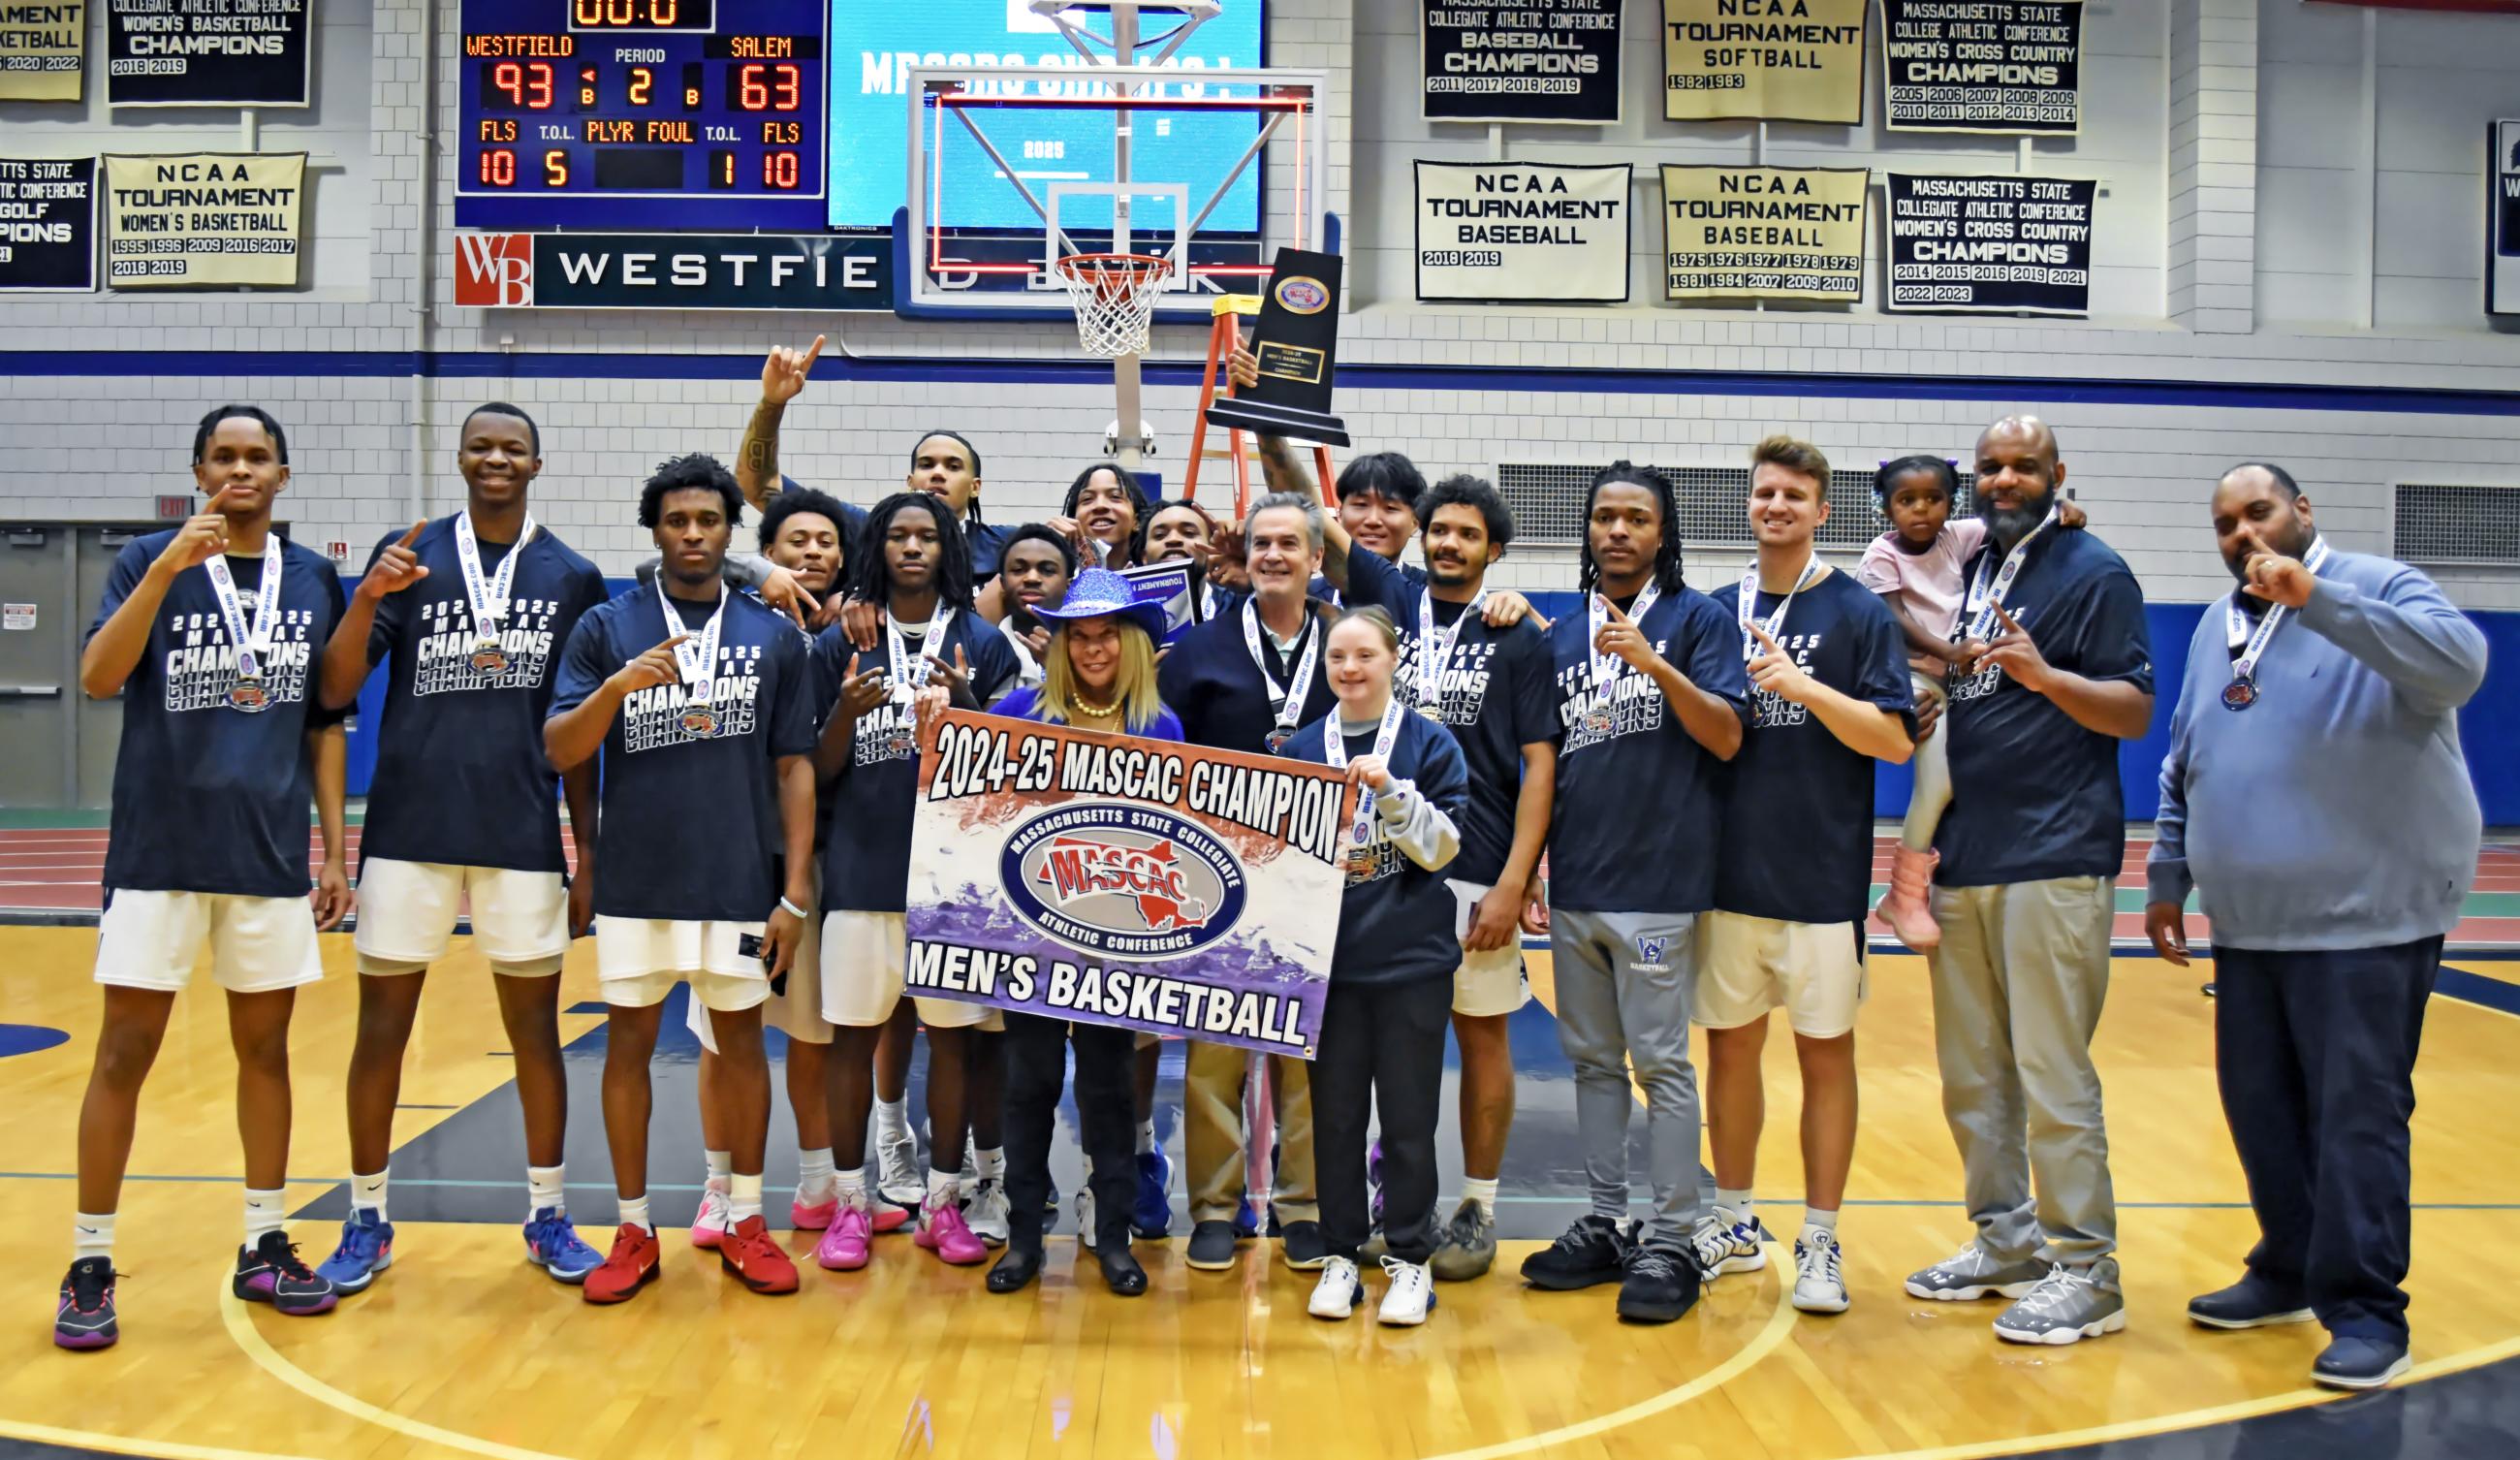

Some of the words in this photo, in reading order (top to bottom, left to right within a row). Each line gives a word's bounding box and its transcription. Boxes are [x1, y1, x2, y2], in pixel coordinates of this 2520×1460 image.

[113, 0, 173, 13] COLLEGIATE
[181, 0, 229, 13] ATHLETIC
[236, 0, 300, 13] CONFERENCE
[1904, 2, 2013, 20] MASSACHUSETTS
[2020, 7, 2062, 22] STATE
[123, 15, 184, 32] WOMEN'S
[193, 16, 291, 32] BASKETBALL
[1430, 11, 1489, 27] COLLEGIATE
[1496, 12, 1542, 28] ATHLETIC
[1549, 13, 1615, 29] CONFERENCE
[1462, 32, 1584, 49] BASEBALL
[1668, 22, 1860, 45] TOURNAMENT
[1895, 22, 1941, 38] COLLEGE
[1949, 23, 1998, 40] ATHLETIC
[2004, 25, 2069, 42] CONFERENCE
[130, 36, 284, 54] CHAMPIONS
[467, 36, 573, 56] WESTFIELD
[732, 37, 792, 57] SALEM
[1889, 41, 1949, 58] WOMEN'S
[1956, 44, 2003, 60] CROSS
[2010, 46, 2075, 62] COUNTRY
[7, 57, 40, 69] 2020
[46, 57, 78, 70] 2022
[615, 48, 666, 63] PERIOD
[1445, 52, 1598, 74] CHAMPIONS
[1704, 48, 1822, 69] SOFTBALL
[113, 61, 145, 74] 2018
[152, 60, 184, 73] 2019
[1907, 62, 2058, 85] CHAMPIONS
[495, 63, 552, 108] 93
[630, 69, 650, 104] 2
[742, 65, 798, 110] 63
[1430, 79, 1460, 91] 2011
[1466, 79, 1498, 91] 2017
[1505, 79, 1539, 91] 2018
[1544, 79, 1577, 92] 2019
[1892, 88, 1924, 100] 2005
[1930, 88, 1962, 101] 2006
[1967, 89, 1999, 102] 2007
[2005, 90, 2037, 103] 2008
[2042, 91, 2074, 104] 2009
[1893, 106, 1924, 118] 2010
[1931, 106, 1960, 118] 2011
[1969, 107, 2000, 118] 2012
[2005, 107, 2037, 119] 2013
[2042, 108, 2074, 120] 2014
[481, 121, 516, 141] FLS
[539, 126, 575, 140] T.O.L.
[587, 121, 634, 142] PLYR
[647, 122, 693, 143] FOUL
[705, 127, 741, 141] T.O.L.
[764, 123, 799, 143] FLS
[33, 163, 73, 178] STATE
[158, 164, 249, 182] NCAA
[482, 149, 514, 184] 10
[726, 154, 733, 184] 1
[766, 153, 797, 187] 10
[20, 182, 87, 199] CONFERENCE
[1476, 175, 1567, 193] NCAA
[1719, 175, 1811, 195] NCAA
[1912, 179, 2024, 198] MASSACHUSETTS
[2032, 183, 2070, 200] STATE
[114, 189, 295, 206] TOURNAMENT
[0, 203, 49, 219] GOLF
[1427, 199, 1619, 219] TOURNAMENT
[1669, 201, 1860, 222] TOURNAMENT
[1897, 200, 1958, 217] COLLEGIATE
[1965, 203, 2013, 218] ATHLETIC
[2019, 203, 2086, 220] CONFERENCE
[121, 212, 184, 232] WOMEN'S
[192, 213, 287, 231] BASKETBALL
[1895, 219, 1957, 237] WOMEN'S
[1965, 222, 2014, 238] CROSS
[2021, 223, 2088, 241] COUNTRY
[1458, 225, 1587, 244] BASEBALL
[1704, 226, 1823, 247] BASEBALL
[114, 241, 145, 253] 1995
[151, 240, 182, 252] 1996
[188, 238, 221, 252] 2009
[226, 239, 259, 252] 2016
[262, 239, 295, 253] 2017
[1913, 241, 2068, 264] CHAMPIONS
[114, 262, 146, 274] 2018
[152, 261, 184, 273] 2019
[1424, 252, 1459, 265] 2018
[1465, 252, 1499, 266] 2019
[1672, 254, 1706, 267] 1975
[1710, 253, 1744, 267] 1976
[1747, 254, 1781, 267] 1977
[1785, 255, 1819, 268] 1978
[1822, 257, 1858, 270] 1979
[1672, 275, 1706, 288] 1981
[1710, 274, 1744, 287] 1984
[1748, 274, 1780, 287] 2007
[1786, 276, 1818, 289] 2009
[1822, 277, 1855, 290] 2010
[1898, 267, 1930, 278] 2014
[1936, 267, 1969, 278] 2015
[1974, 268, 2006, 279] 2016
[2014, 269, 2045, 281] 2019
[2052, 271, 2083, 283] 2021
[1898, 288, 1931, 300] 2022
[1937, 288, 1969, 300] 2023
[161, 496, 186, 517] EXIT
[467, 562, 485, 610] mascac.com
[929, 721, 1058, 803] 2024-25
[1061, 744, 1181, 804] MASCAC
[1188, 761, 1344, 866] CHAMPION
[1010, 809, 1124, 854] MASSACHUSETTS
[1131, 812, 1172, 834] STATE
[1177, 827, 1241, 888] COLLEGIATE
[1038, 911, 1099, 945] ATHLETIC
[1107, 933, 1193, 951] CONFERENCE
[906, 940, 1037, 1001] MEN'S
[1048, 964, 1307, 1046] BASKETBALL
